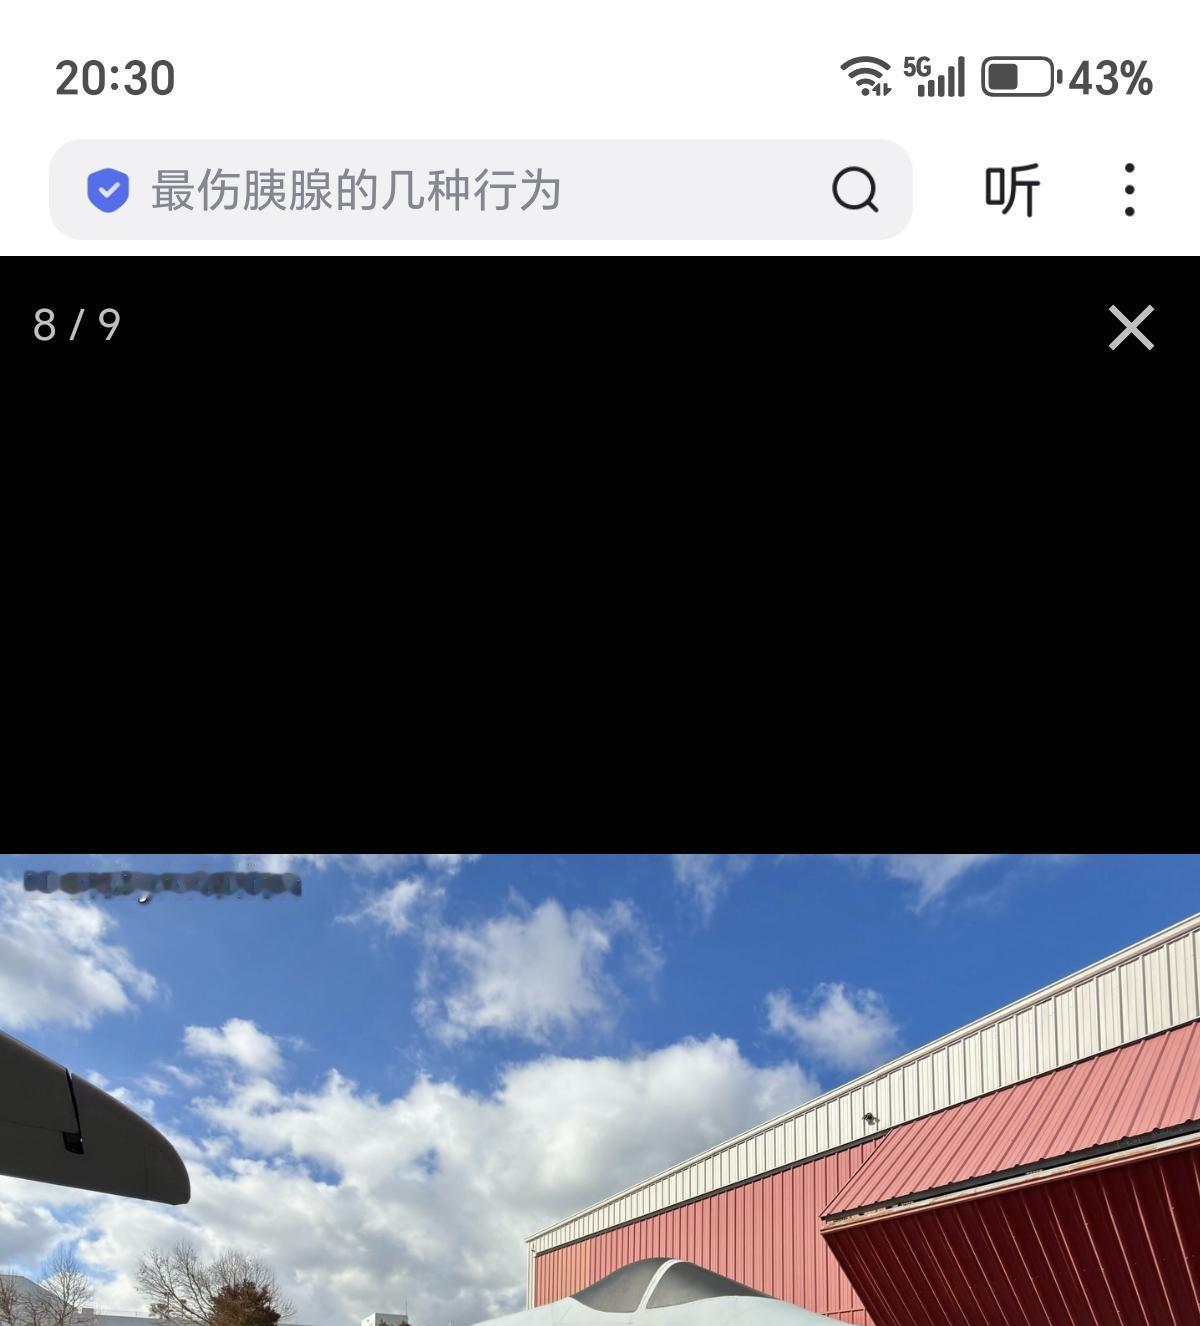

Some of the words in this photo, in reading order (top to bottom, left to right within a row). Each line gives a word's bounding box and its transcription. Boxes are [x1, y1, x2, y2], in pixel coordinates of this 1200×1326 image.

[55, 59, 175, 96] 20:30
[903, 56, 932, 78] 5G
[1068, 59, 1154, 96] 43%
[151, 167, 560, 212] 最伤胰腺的几种行为
[985, 162, 1041, 219] 听
[33, 307, 56, 342] 8
[98, 307, 121, 341] 9
